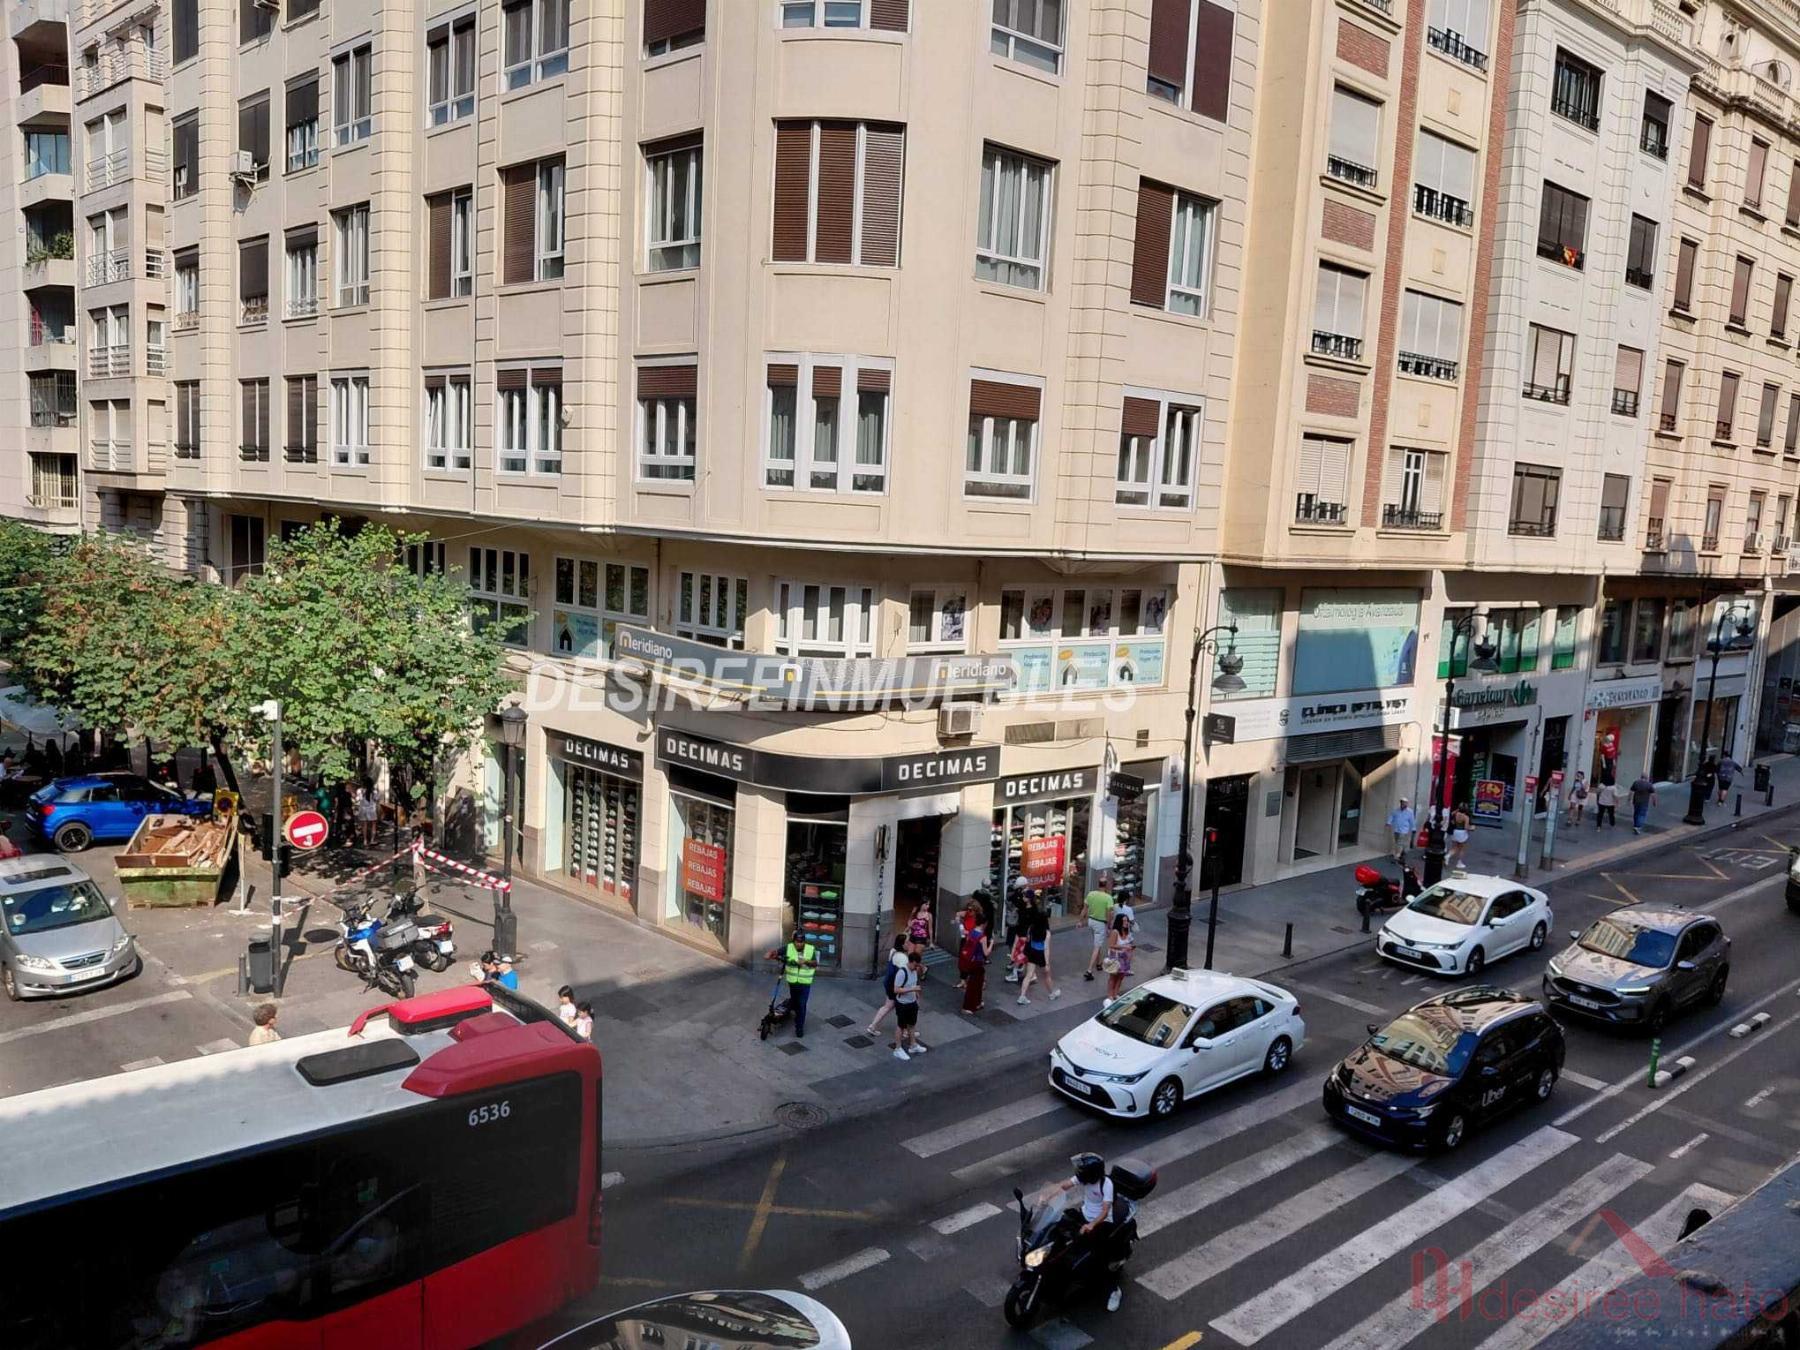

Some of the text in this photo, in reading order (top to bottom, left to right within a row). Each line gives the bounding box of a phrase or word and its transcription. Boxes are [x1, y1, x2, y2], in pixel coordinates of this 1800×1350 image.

[565, 739, 629, 769] DECIMAS
[666, 737, 744, 772] DECIMAS
[898, 755, 988, 781] DECIMAS
[1006, 772, 1084, 798] DECIMAS
[689, 842, 718, 859] REBAJAS
[688, 861, 717, 877] REBAJAS
[687, 879, 717, 896] REBAJAS
[1482, 1085, 1507, 1108] Uber
[468, 1100, 511, 1127] 6536
